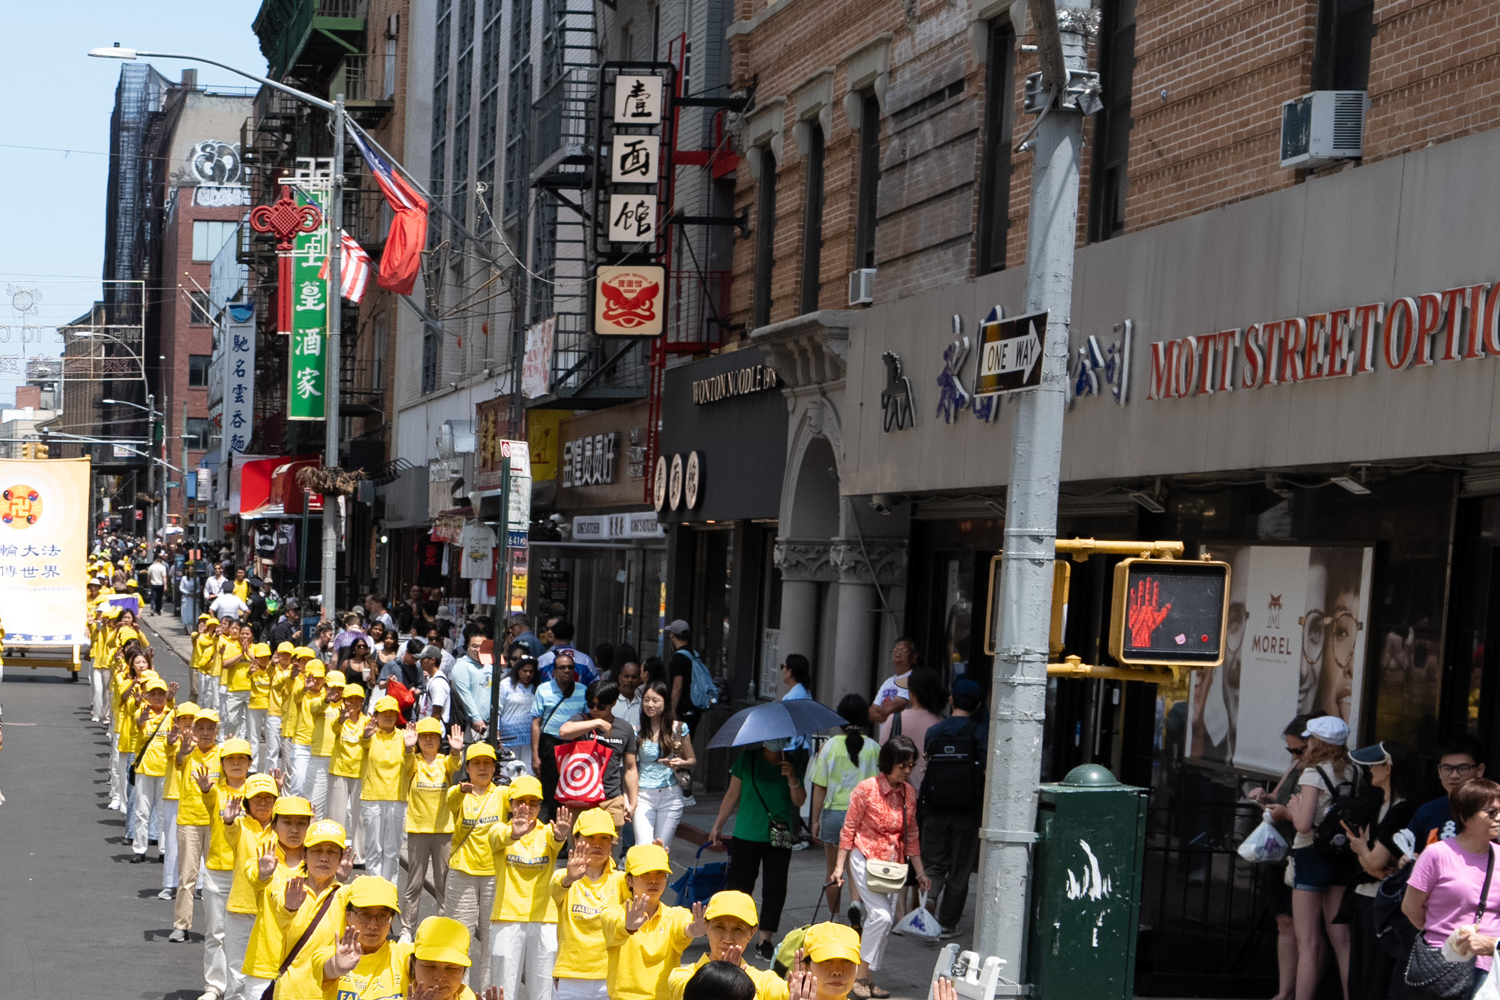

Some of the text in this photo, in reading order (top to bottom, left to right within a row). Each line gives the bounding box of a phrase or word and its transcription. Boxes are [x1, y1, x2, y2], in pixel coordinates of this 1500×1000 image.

[987, 337, 1037, 372] ONE WAY
[1147, 327, 1241, 400] MOTT
[1242, 302, 1384, 390] STREET
[693, 374, 726, 404] WONTON
[727, 365, 762, 397] NOODLE
[1252, 634, 1292, 655] MOREL
[507, 855, 548, 865] FALUN DAFA
